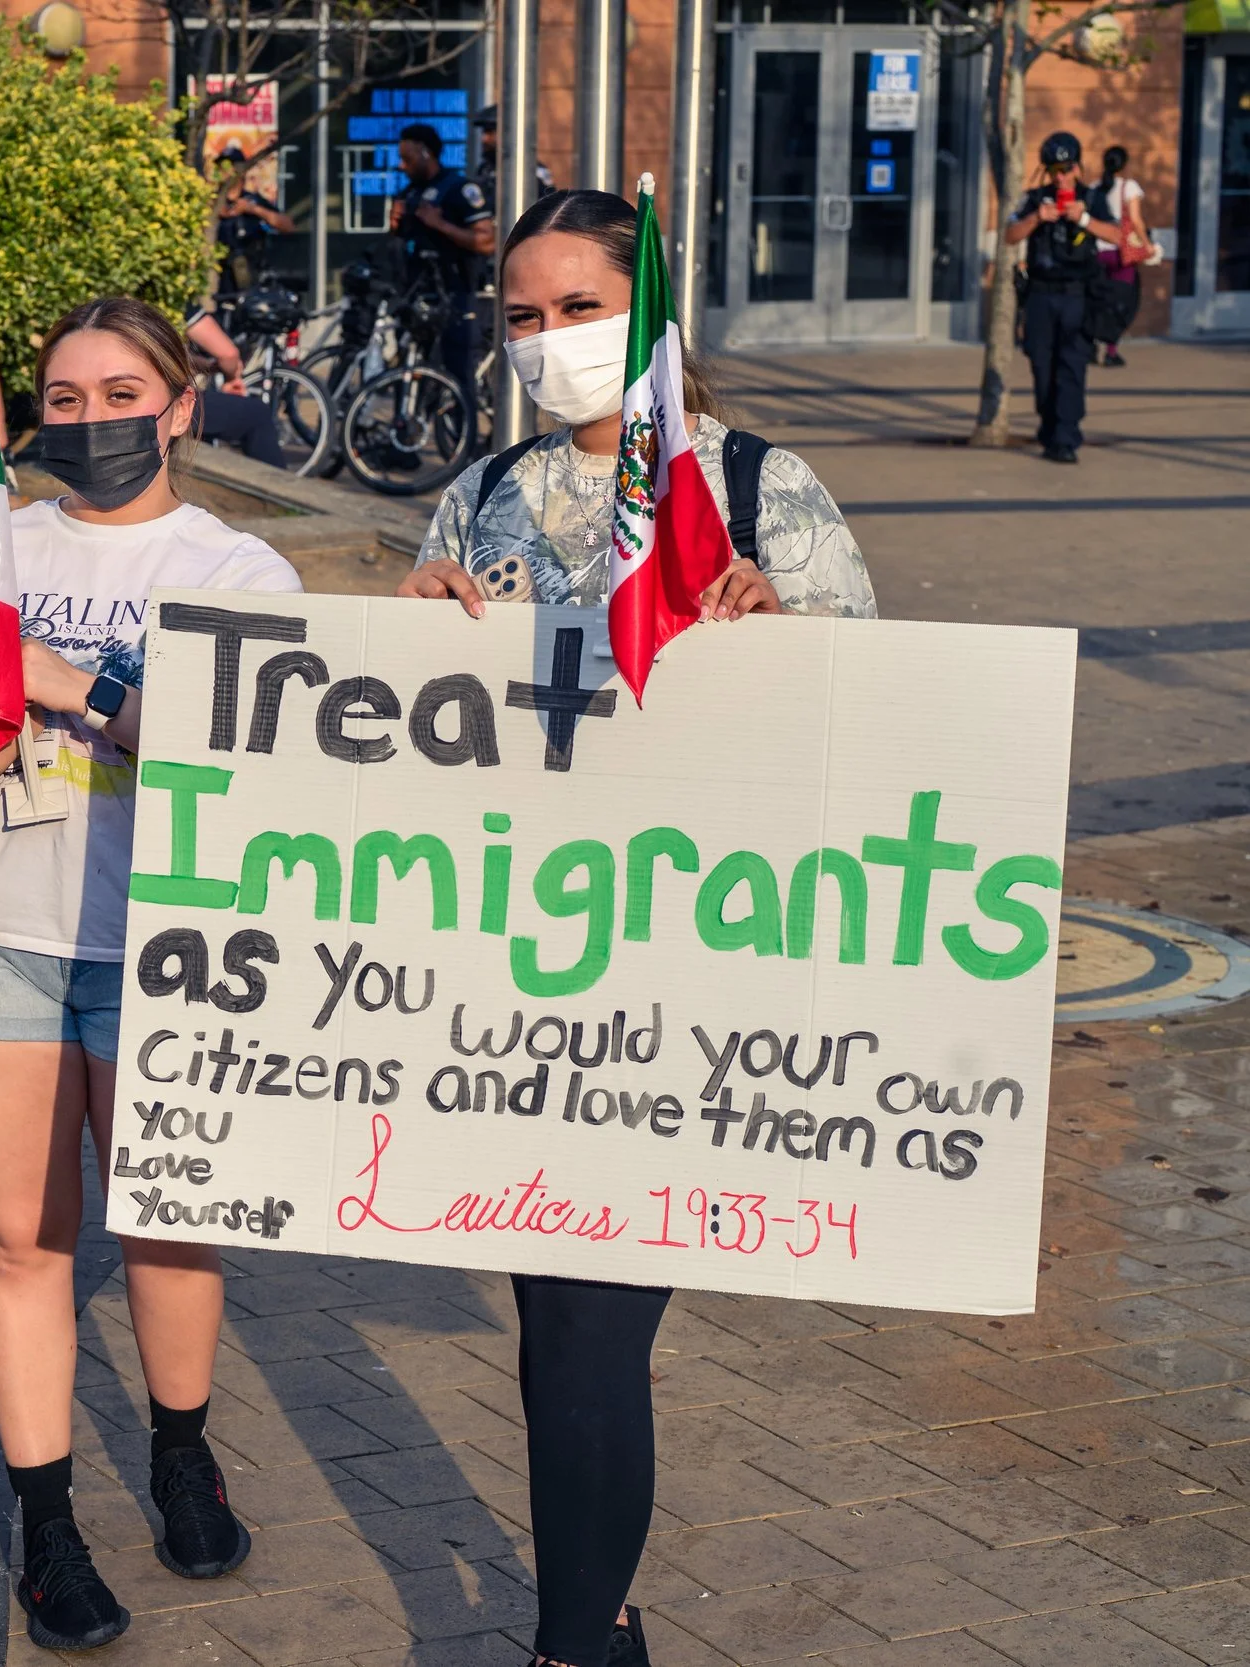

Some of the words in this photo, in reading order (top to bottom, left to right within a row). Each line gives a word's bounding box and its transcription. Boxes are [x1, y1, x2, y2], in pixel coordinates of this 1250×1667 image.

[58, 623, 117, 636] ISLAND
[159, 602, 617, 772] Treat
[128, 760, 1062, 998] Immigrants
[137, 927, 280, 1013] as
[449, 1003, 661, 1068] would
[691, 1024, 879, 1101] your
[876, 1072, 1024, 1121] own
[137, 1028, 404, 1106] Citizens
[426, 1064, 549, 1117] and
[562, 1072, 685, 1137] love
[701, 1087, 876, 1168] them
[896, 1128, 984, 1181] as
[638, 1186, 858, 1259] 19:33-34
